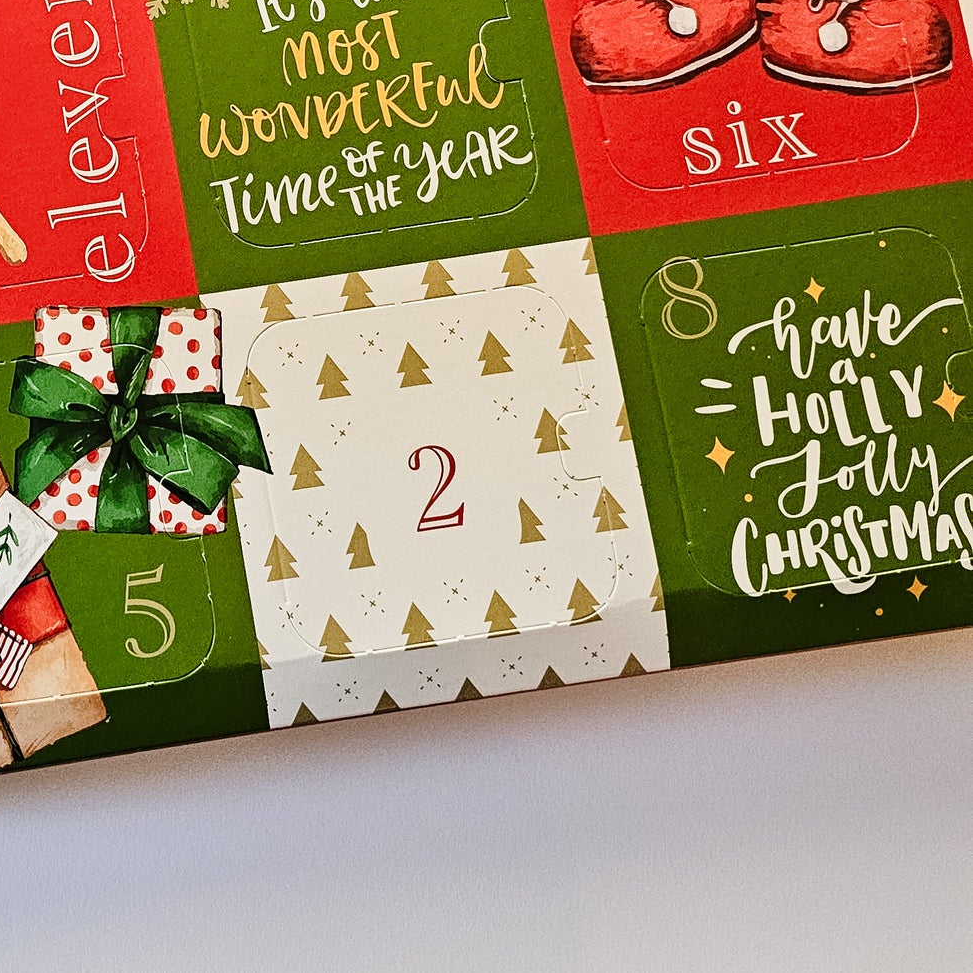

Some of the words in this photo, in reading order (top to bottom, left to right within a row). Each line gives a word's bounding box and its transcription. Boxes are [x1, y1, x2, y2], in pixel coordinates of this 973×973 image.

[682, 101, 818, 176] six
[338, 174, 403, 216] THE
[659, 256, 718, 340] 8
[727, 289, 964, 380] have
[752, 365, 924, 447] HOLLY
[829, 358, 859, 386] a
[407, 445, 465, 533] 2
[750, 433, 973, 519] Jolly
[123, 564, 177, 659] 5
